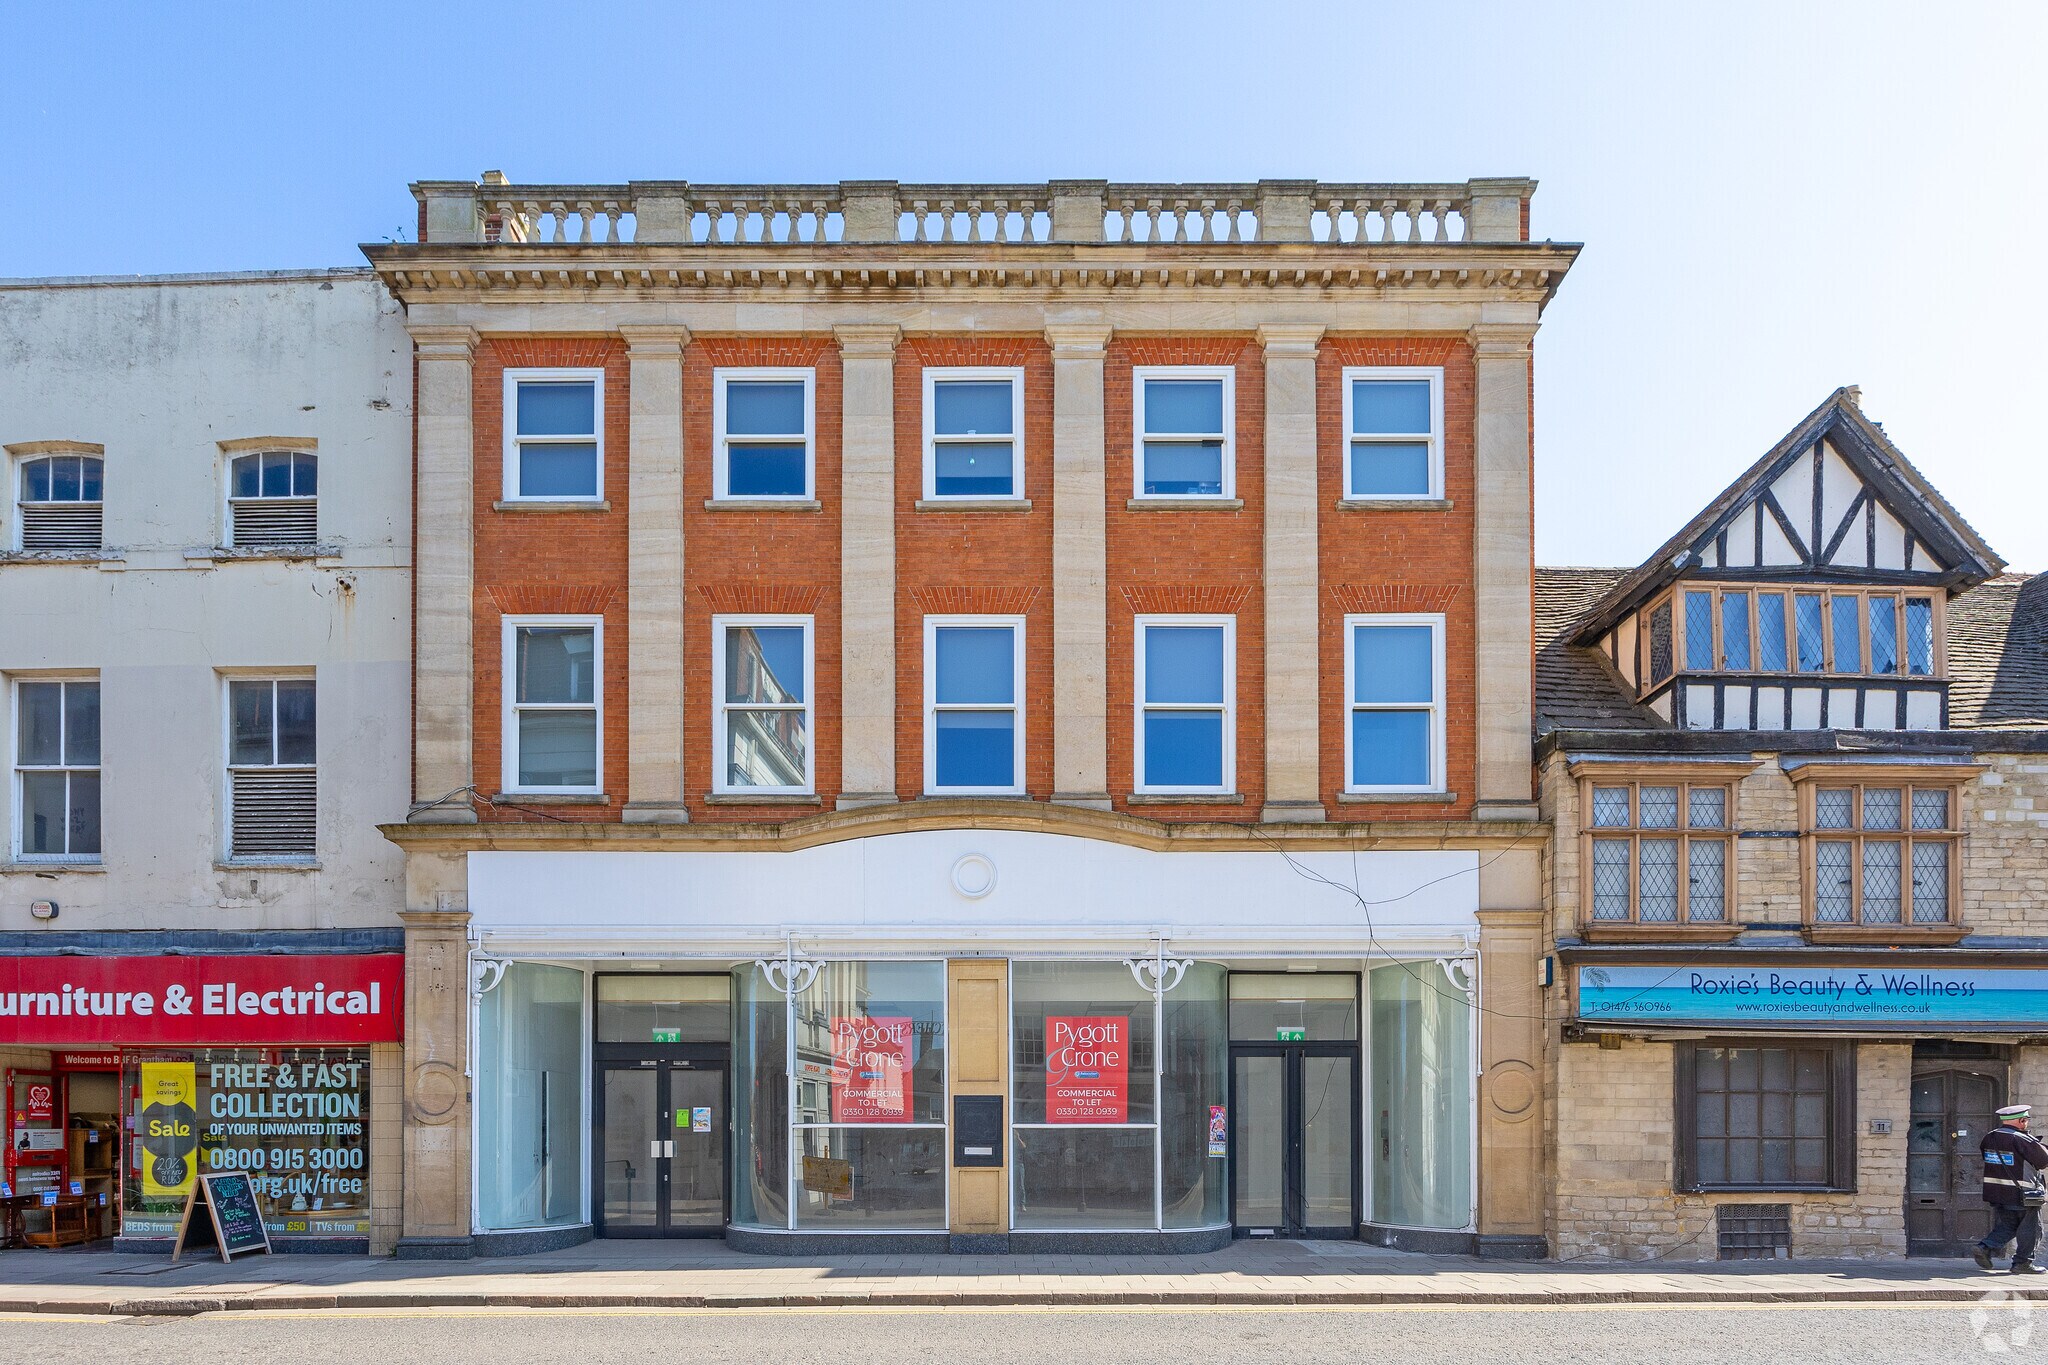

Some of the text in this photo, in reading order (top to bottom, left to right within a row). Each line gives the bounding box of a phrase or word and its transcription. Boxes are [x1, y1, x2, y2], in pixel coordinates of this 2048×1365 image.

[1691, 973, 1975, 1000] Roxie's Beauty & Wellness
[163, 984, 193, 1016] &
[203, 982, 380, 1016] Electrical
[1601, 1002, 1630, 1012] 01476
[1634, 1002, 1672, 1012] 360966
[1736, 1002, 1930, 1014] www.roxiesbeautyandwellness.co.uk
[840, 1022, 903, 1048] Pygott
[1056, 1022, 1118, 1048] Pygott
[65, 1055, 102, 1064] Welcome
[103, 1056, 112, 1064] to
[846, 1048, 904, 1067] Crone
[1062, 1048, 1118, 1066] Crone
[210, 1064, 362, 1088] FREE & FAST
[210, 1093, 360, 1118] COLLECTION
[842, 1108, 904, 1116] 0330 128 0939
[149, 1120, 190, 1137] Sale
[210, 1123, 362, 1135] OF YOUR UNWANTED ITEMS
[210, 1148, 363, 1170] 0800 915 3000
[126, 1222, 150, 1232] BEDS
[152, 1222, 172, 1232] from
[264, 1221, 284, 1231] from
[287, 1221, 306, 1231] £50
[316, 1221, 332, 1231] TVs
[334, 1221, 354, 1231] from
